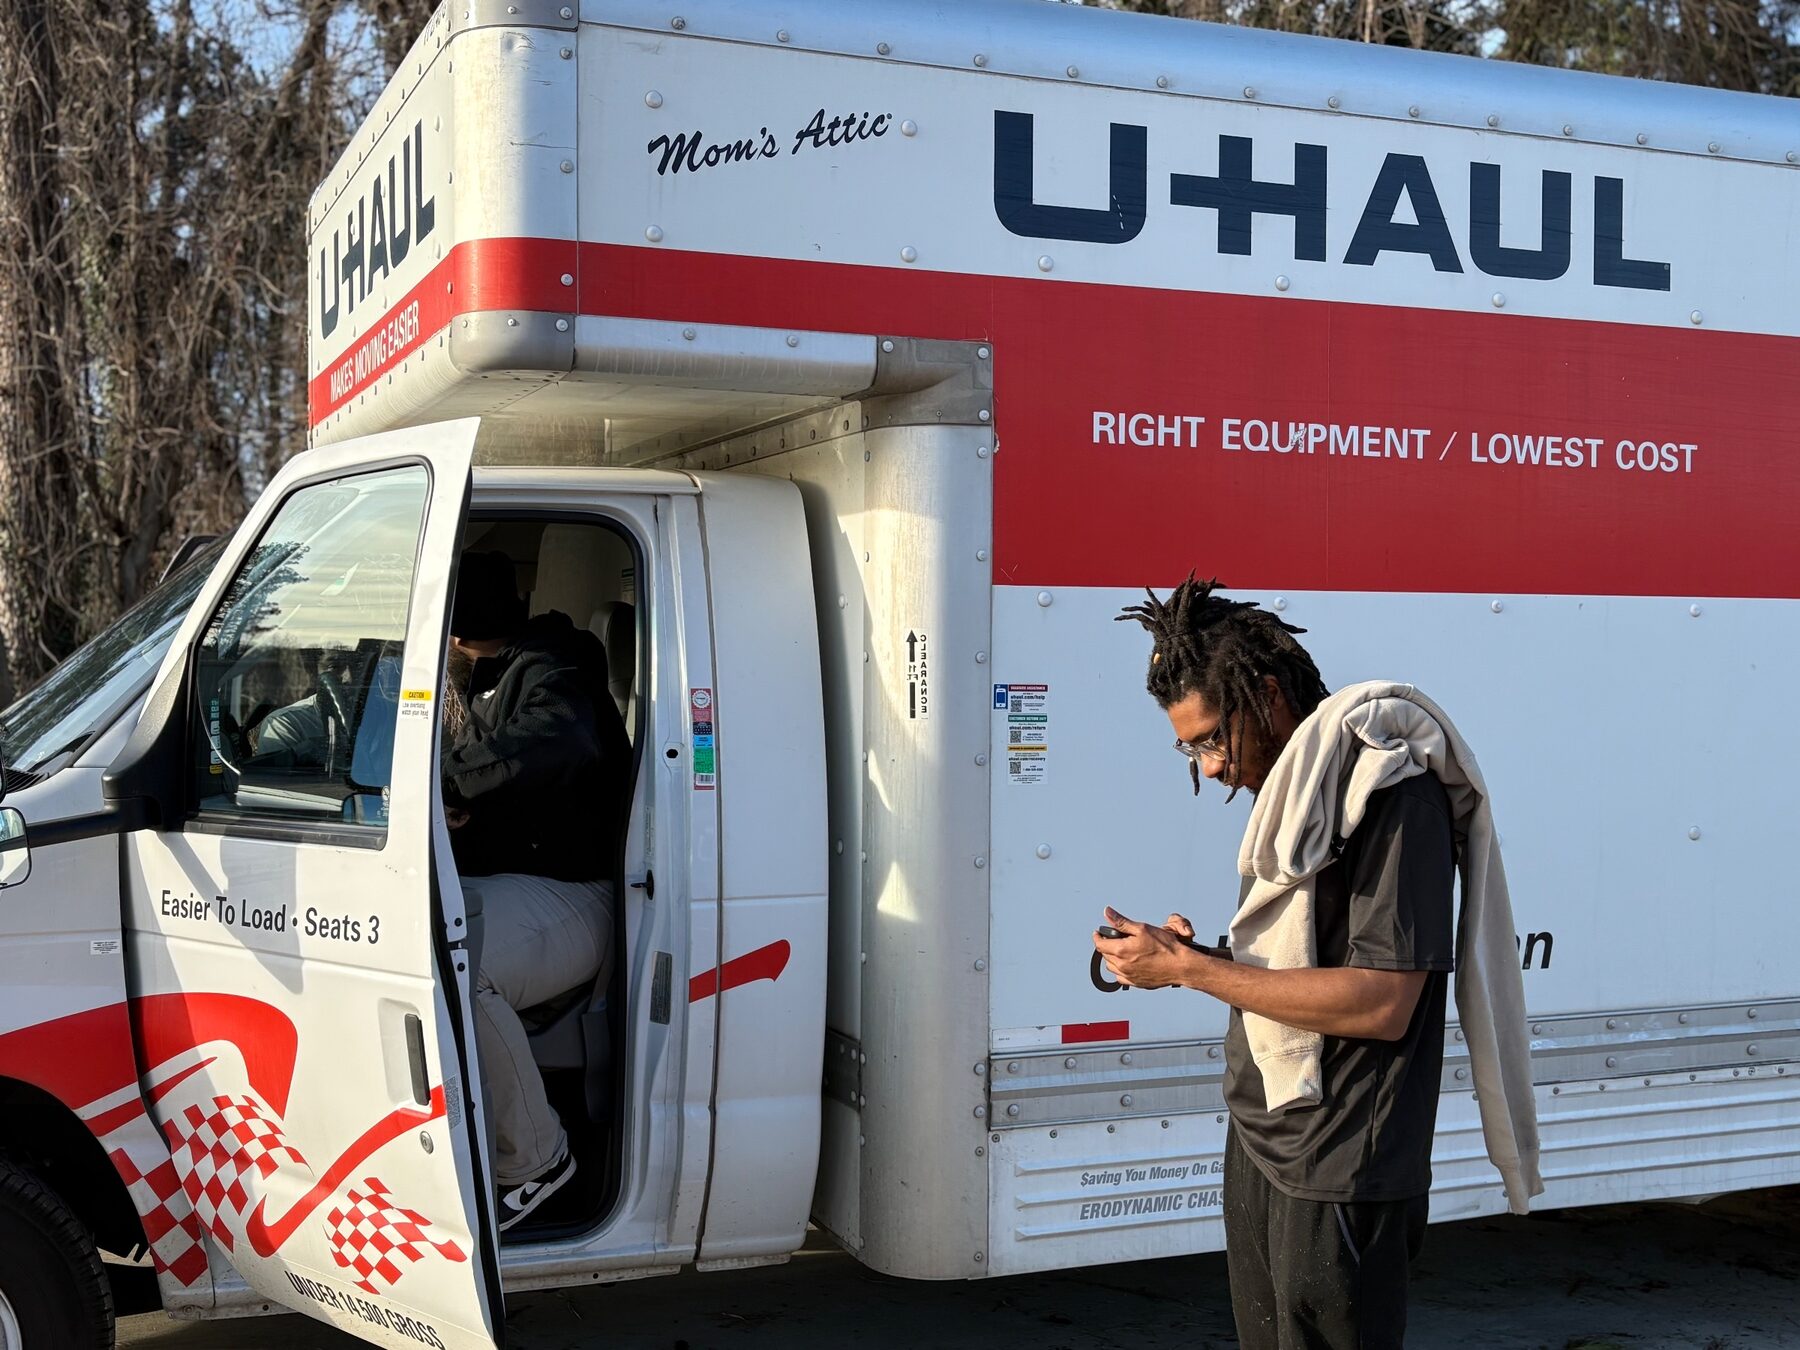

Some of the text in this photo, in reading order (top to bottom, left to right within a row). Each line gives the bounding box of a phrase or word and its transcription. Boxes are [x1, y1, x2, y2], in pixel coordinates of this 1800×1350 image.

[647, 108, 889, 176] Mom's Attic
[320, 118, 435, 340] U-HAUL
[993, 109, 1671, 292] U-HAUL
[330, 299, 419, 404] MAKES MOVING EASIER
[1092, 411, 1698, 473] RIGHT EQUIPMENT / LOWEST COST
[161, 889, 211, 921] Easier
[216, 895, 236, 925] To
[241, 898, 287, 933] Load
[304, 906, 361, 943] Seats
[367, 914, 380, 945] 3
[1125, 1168, 1146, 1182] You
[1149, 1165, 1189, 1180] Money
[1192, 1162, 1208, 1176] On
[1079, 1193, 1183, 1220] ERODYNAMIC
[284, 1270, 446, 1350] UNDER 14,500 GROSS
